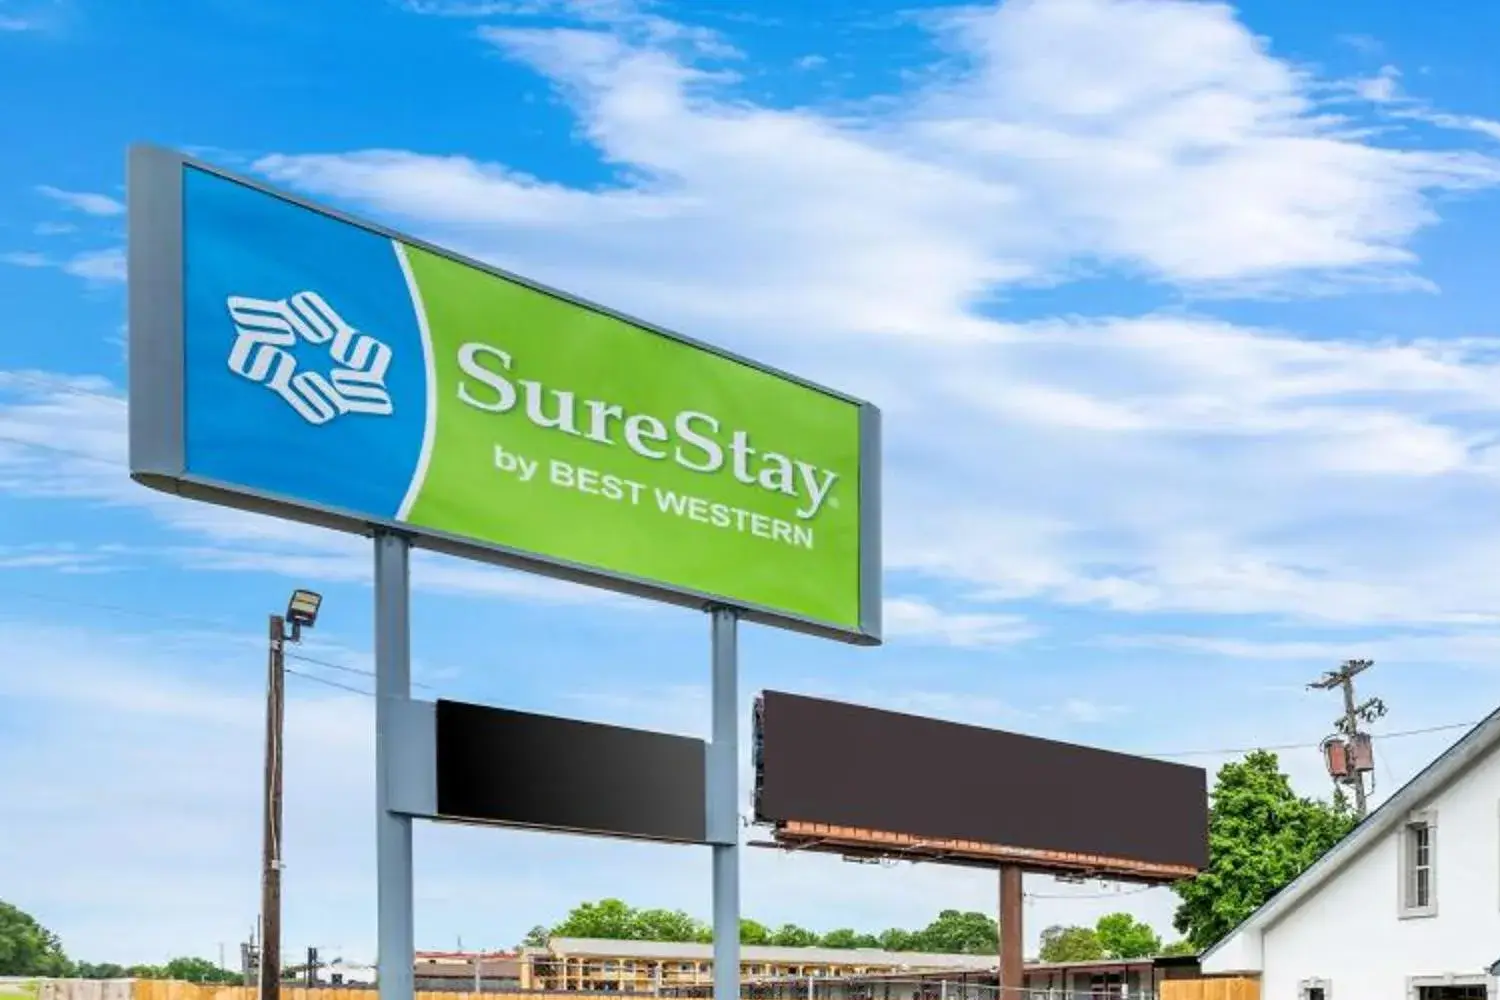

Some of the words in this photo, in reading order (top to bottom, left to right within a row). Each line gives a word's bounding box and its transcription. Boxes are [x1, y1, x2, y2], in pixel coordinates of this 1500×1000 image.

[456, 341, 839, 519] SureStay
[493, 443, 539, 481] by
[549, 458, 647, 505] BEST
[654, 487, 814, 550] WESTERN
